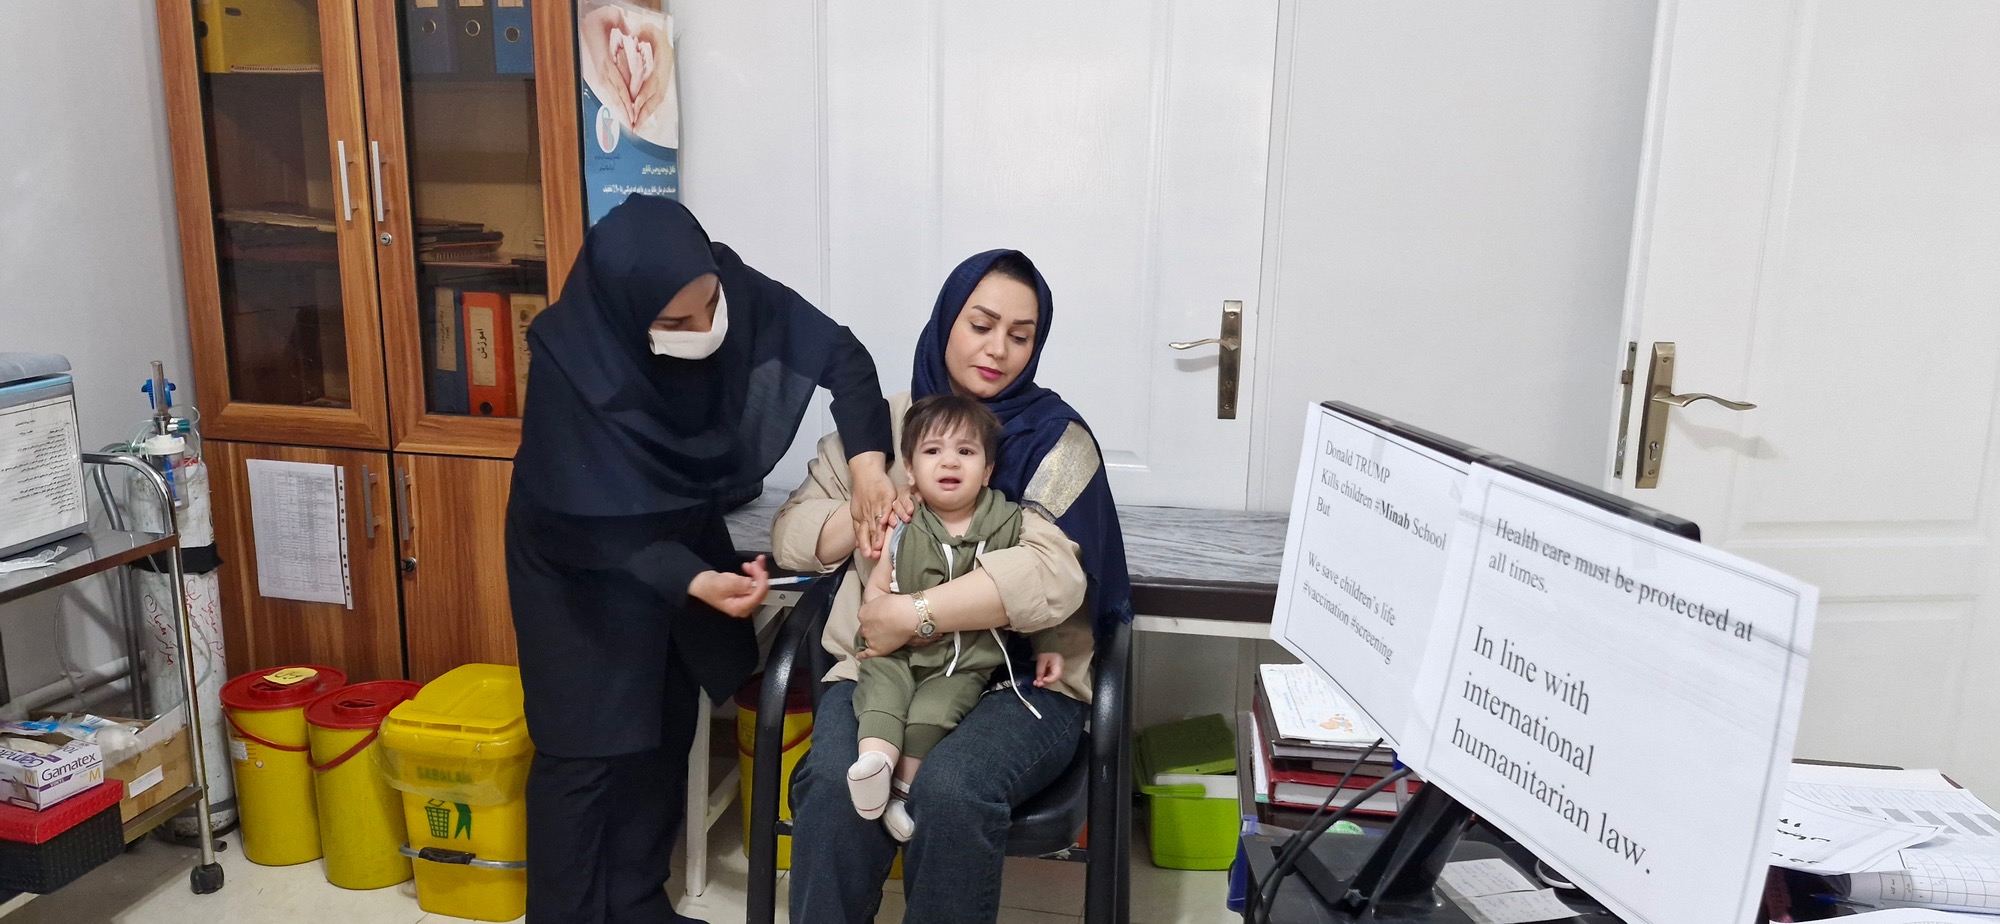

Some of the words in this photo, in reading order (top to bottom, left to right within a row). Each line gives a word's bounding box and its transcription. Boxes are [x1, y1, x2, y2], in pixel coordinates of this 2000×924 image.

[1325, 440, 1353, 466] Donald
[1355, 454, 1390, 484] TRUMP
[1316, 496, 1331, 517] But
[1321, 468, 1339, 490] Kills
[1340, 480, 1373, 509] children
[1374, 498, 1410, 530] #Minab
[1411, 517, 1447, 550] School
[1308, 551, 1321, 572] We
[1321, 565, 1339, 585] save
[1380, 601, 1396, 626] life
[1488, 551, 1505, 575] all
[1508, 559, 1549, 594] times.
[1495, 517, 1538, 553] Health
[1542, 541, 1572, 566] care
[1573, 555, 1611, 585] must
[1614, 565, 1635, 594] be
[1637, 582, 1730, 633] protected
[1734, 617, 1754, 643] at
[1302, 579, 1349, 626] #vaccination
[1350, 615, 1393, 665] #screening
[1472, 624, 1494, 660] In
[1499, 638, 1538, 683] line
[1544, 672, 1591, 716] with
[1462, 671, 1595, 777] international
[24, 770, 36, 784] M
[41, 753, 96, 781] Gamatex
[89, 767, 101, 782] M
[1450, 717, 1591, 834] humanitarian
[1597, 812, 1651, 875] law.
